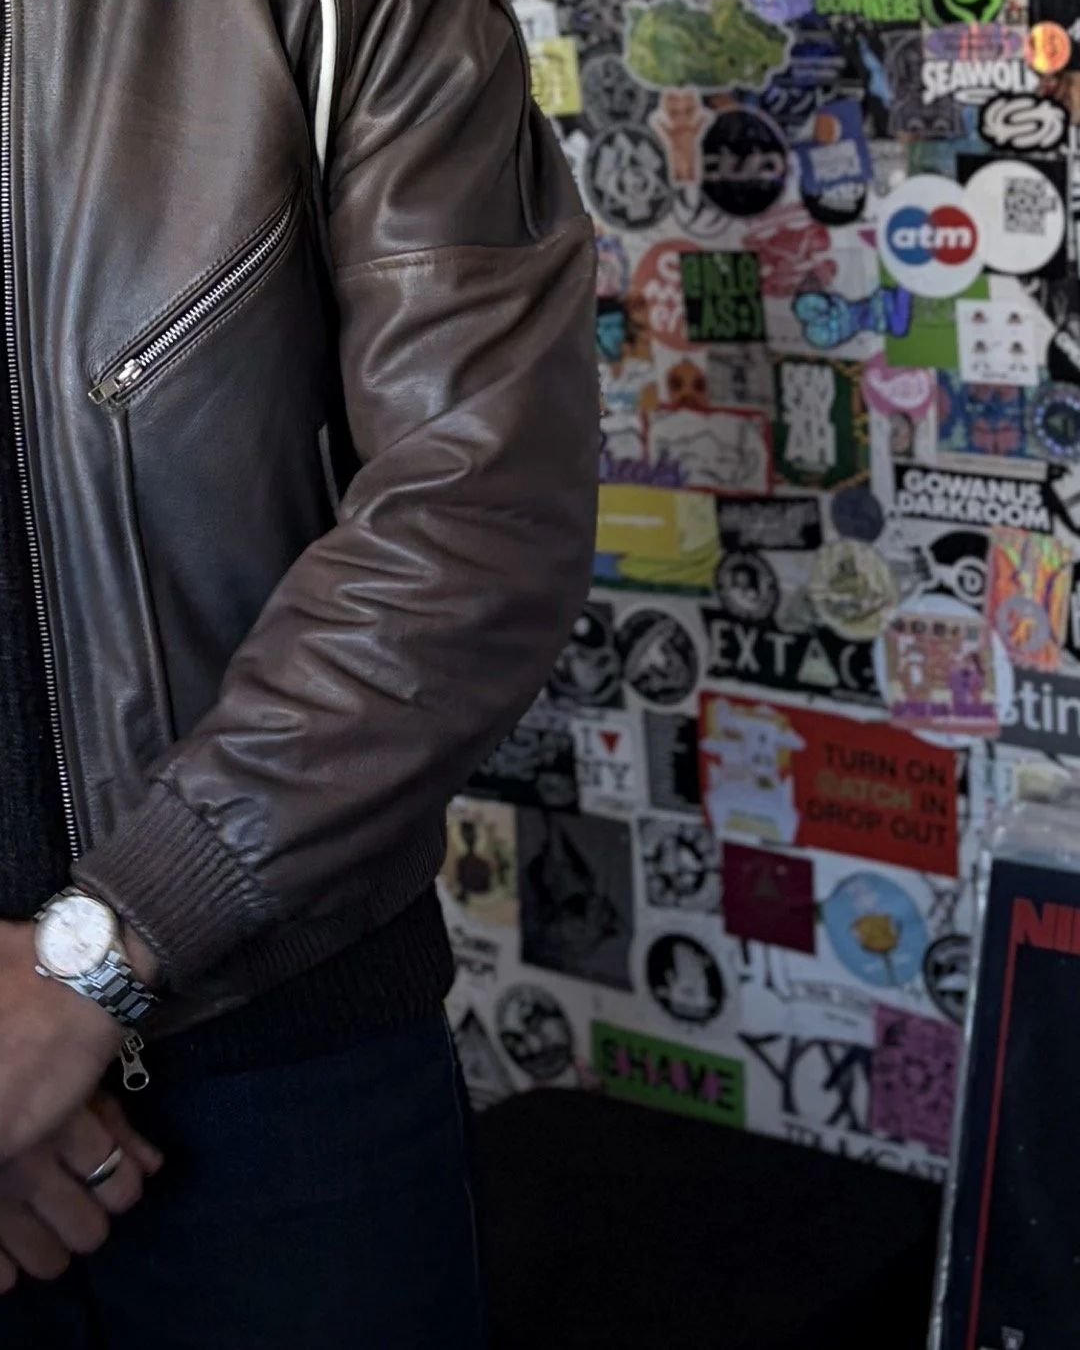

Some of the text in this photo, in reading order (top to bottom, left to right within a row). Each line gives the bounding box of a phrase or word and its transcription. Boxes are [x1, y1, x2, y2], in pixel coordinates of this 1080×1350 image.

[891, 225, 973, 251] atm
[902, 469, 1044, 508] GOWANUS
[897, 492, 1051, 530] DARKROOM
[823, 743, 949, 788] TURN ON
[806, 797, 947, 847] DROP OUT
[920, 789, 948, 819] IN
